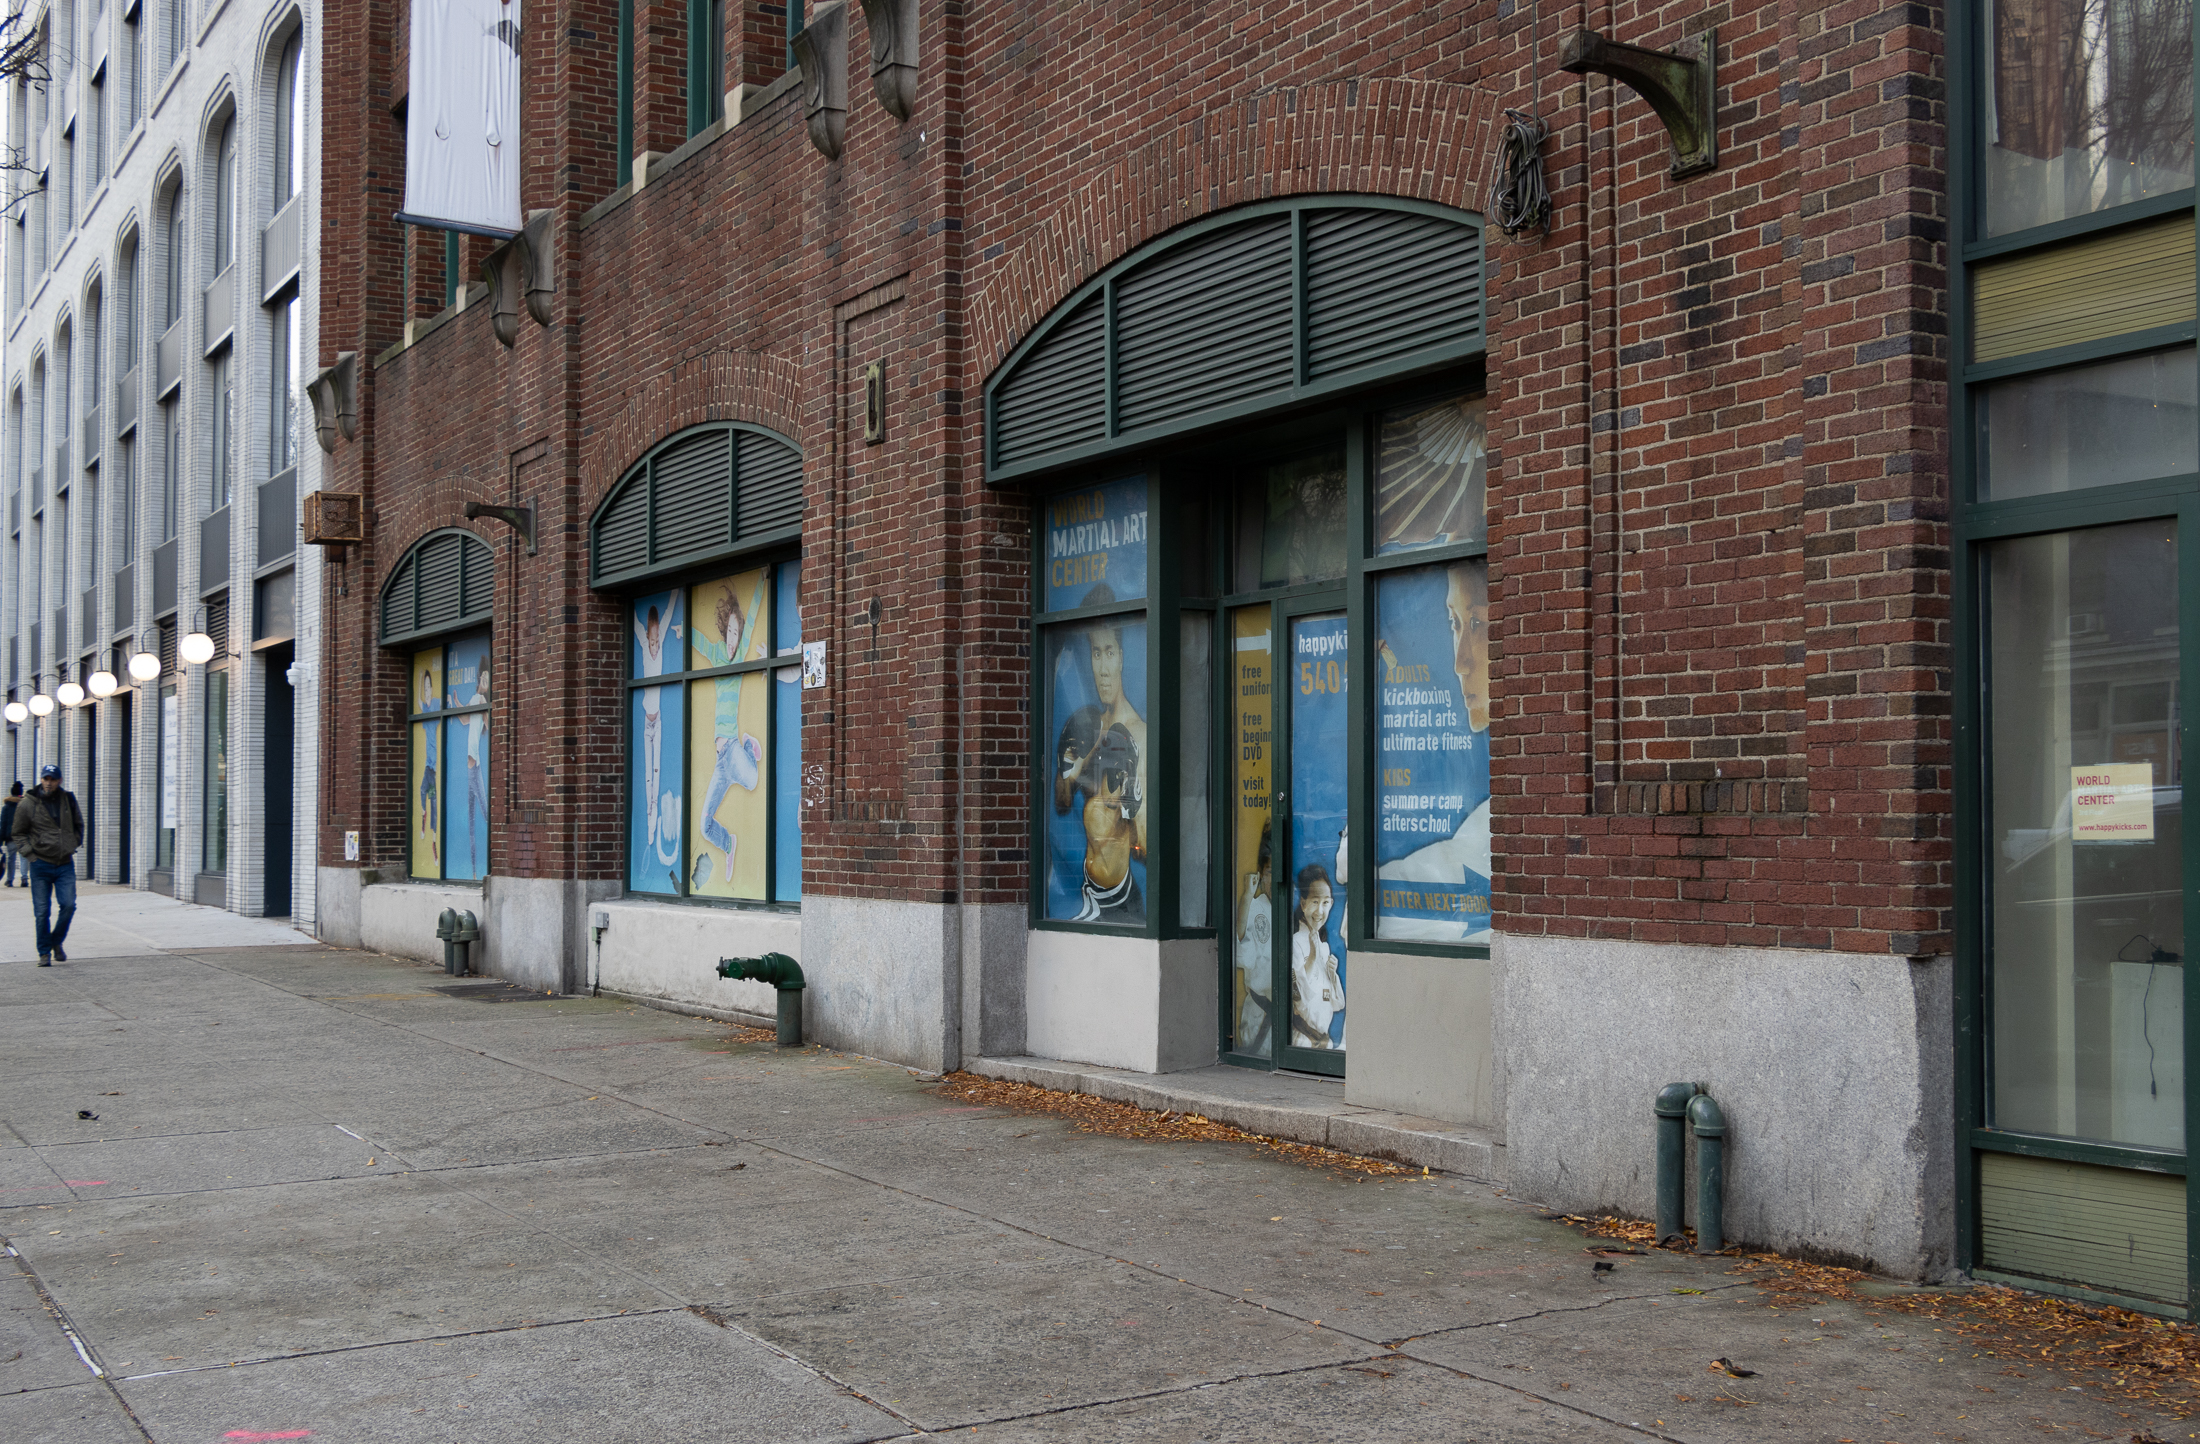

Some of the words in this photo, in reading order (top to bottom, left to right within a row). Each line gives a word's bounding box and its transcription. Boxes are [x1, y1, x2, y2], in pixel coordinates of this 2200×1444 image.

[1053, 490, 1105, 527] WORLD
[1053, 519, 1118, 557] MARTIAL
[1122, 511, 1147, 545] ART
[1052, 552, 1108, 588] CENTER
[448, 668, 464, 686] GREAT
[1242, 664, 1262, 679] free
[1301, 660, 1340, 695] 540
[1384, 664, 1431, 684] ADULTS
[1242, 681, 1271, 696] unifor
[1383, 686, 1452, 708] kickboxing
[1242, 712, 1262, 726] free
[1383, 709, 1433, 728] martial
[1435, 709, 1457, 727] arts
[1383, 733, 1439, 751] ultimate
[1442, 732, 1473, 751] fitness
[1243, 746, 1262, 760] DVD
[1243, 776, 1264, 790] visit
[1383, 768, 1411, 787] KIDS
[2076, 775, 2111, 786] WORLD
[1243, 793, 1271, 811] today!
[1383, 794, 1436, 810] summer
[1438, 794, 1463, 814] camp
[2077, 794, 2115, 806] CENTER
[1383, 813, 1451, 833] afterschool
[2078, 823, 2148, 832] www.happykicks.com
[1383, 889, 1423, 910] ENTER
[1424, 892, 1457, 912] NEXT
[1459, 894, 1491, 914] DOOR
